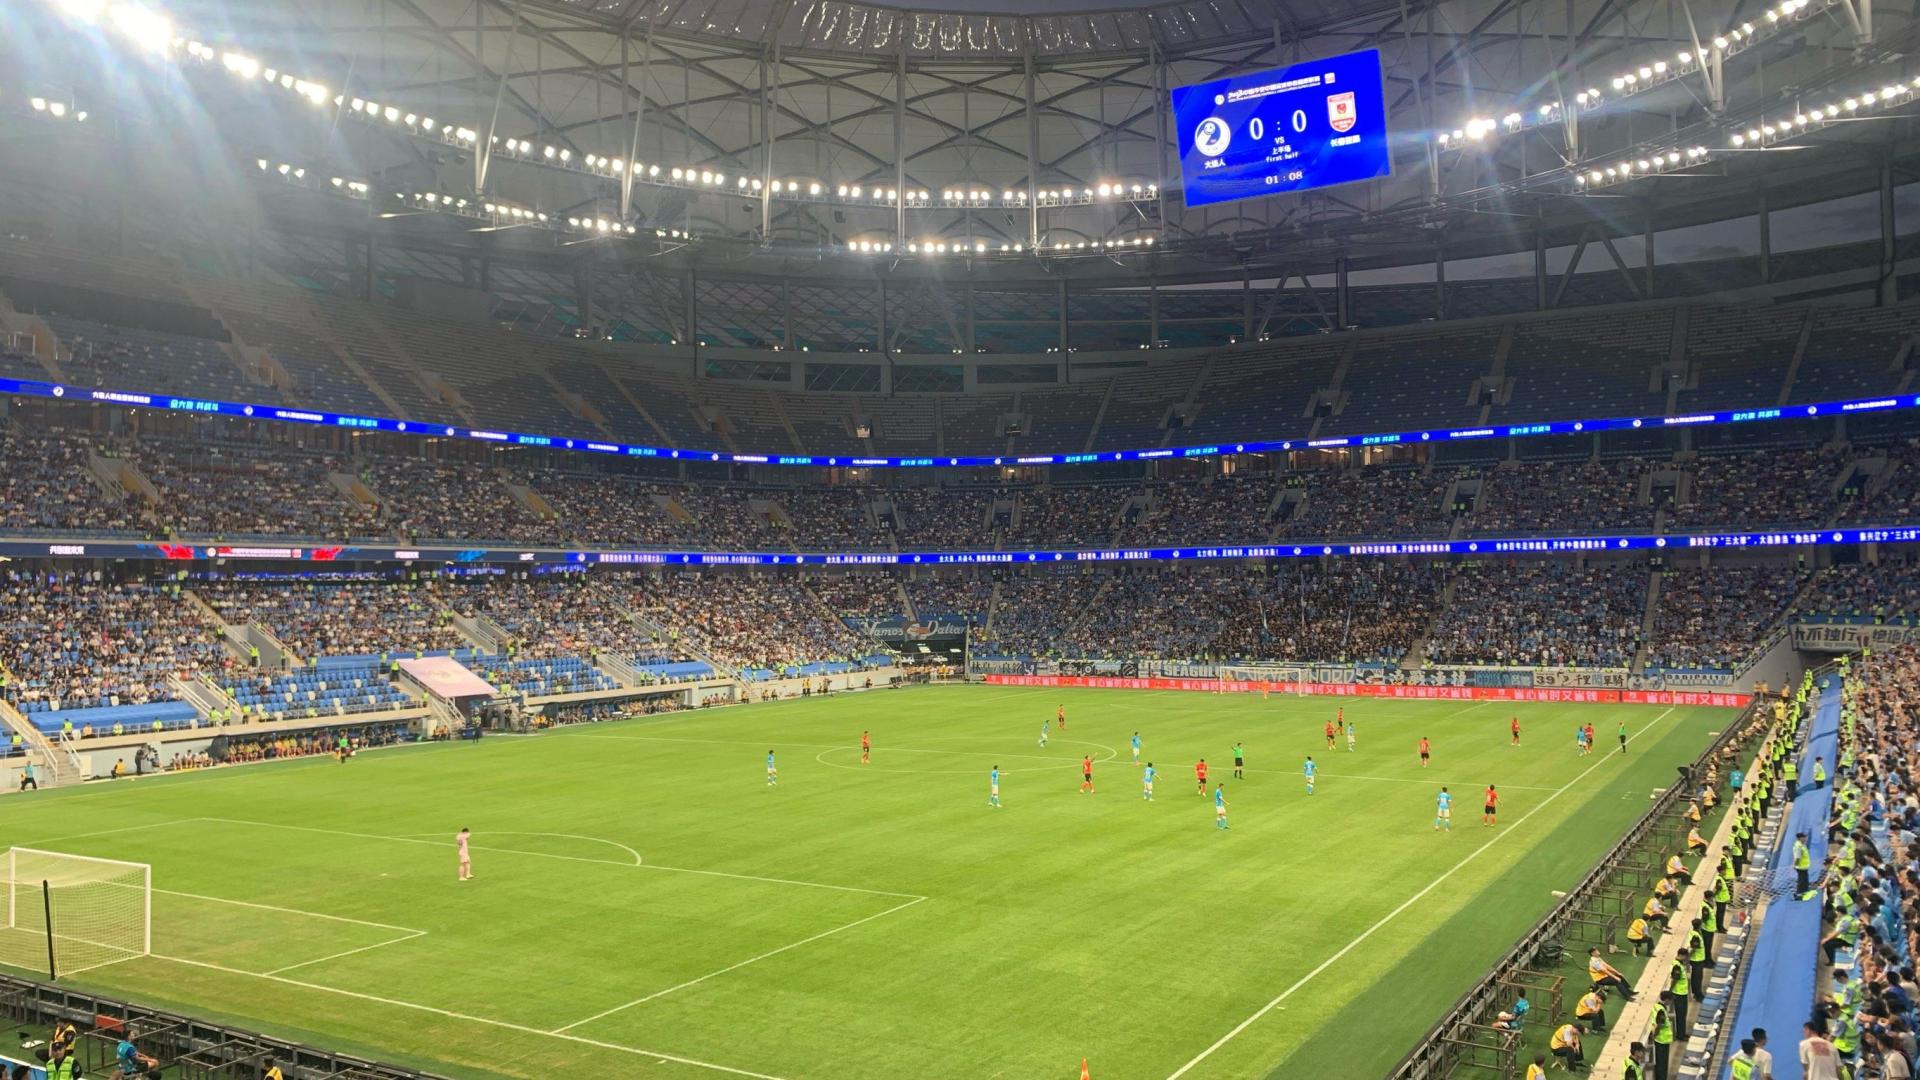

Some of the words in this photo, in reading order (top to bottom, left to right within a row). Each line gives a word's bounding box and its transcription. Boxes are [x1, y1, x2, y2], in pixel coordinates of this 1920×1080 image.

[1250, 117, 1264, 140] 0
[1292, 110, 1307, 132] 0
[1274, 136, 1285, 145] VS
[1204, 158, 1226, 170] 大连人
[864, 620, 903, 637] Vamos
[1308, 668, 1356, 684] NORD
[1536, 675, 1555, 686] 39
